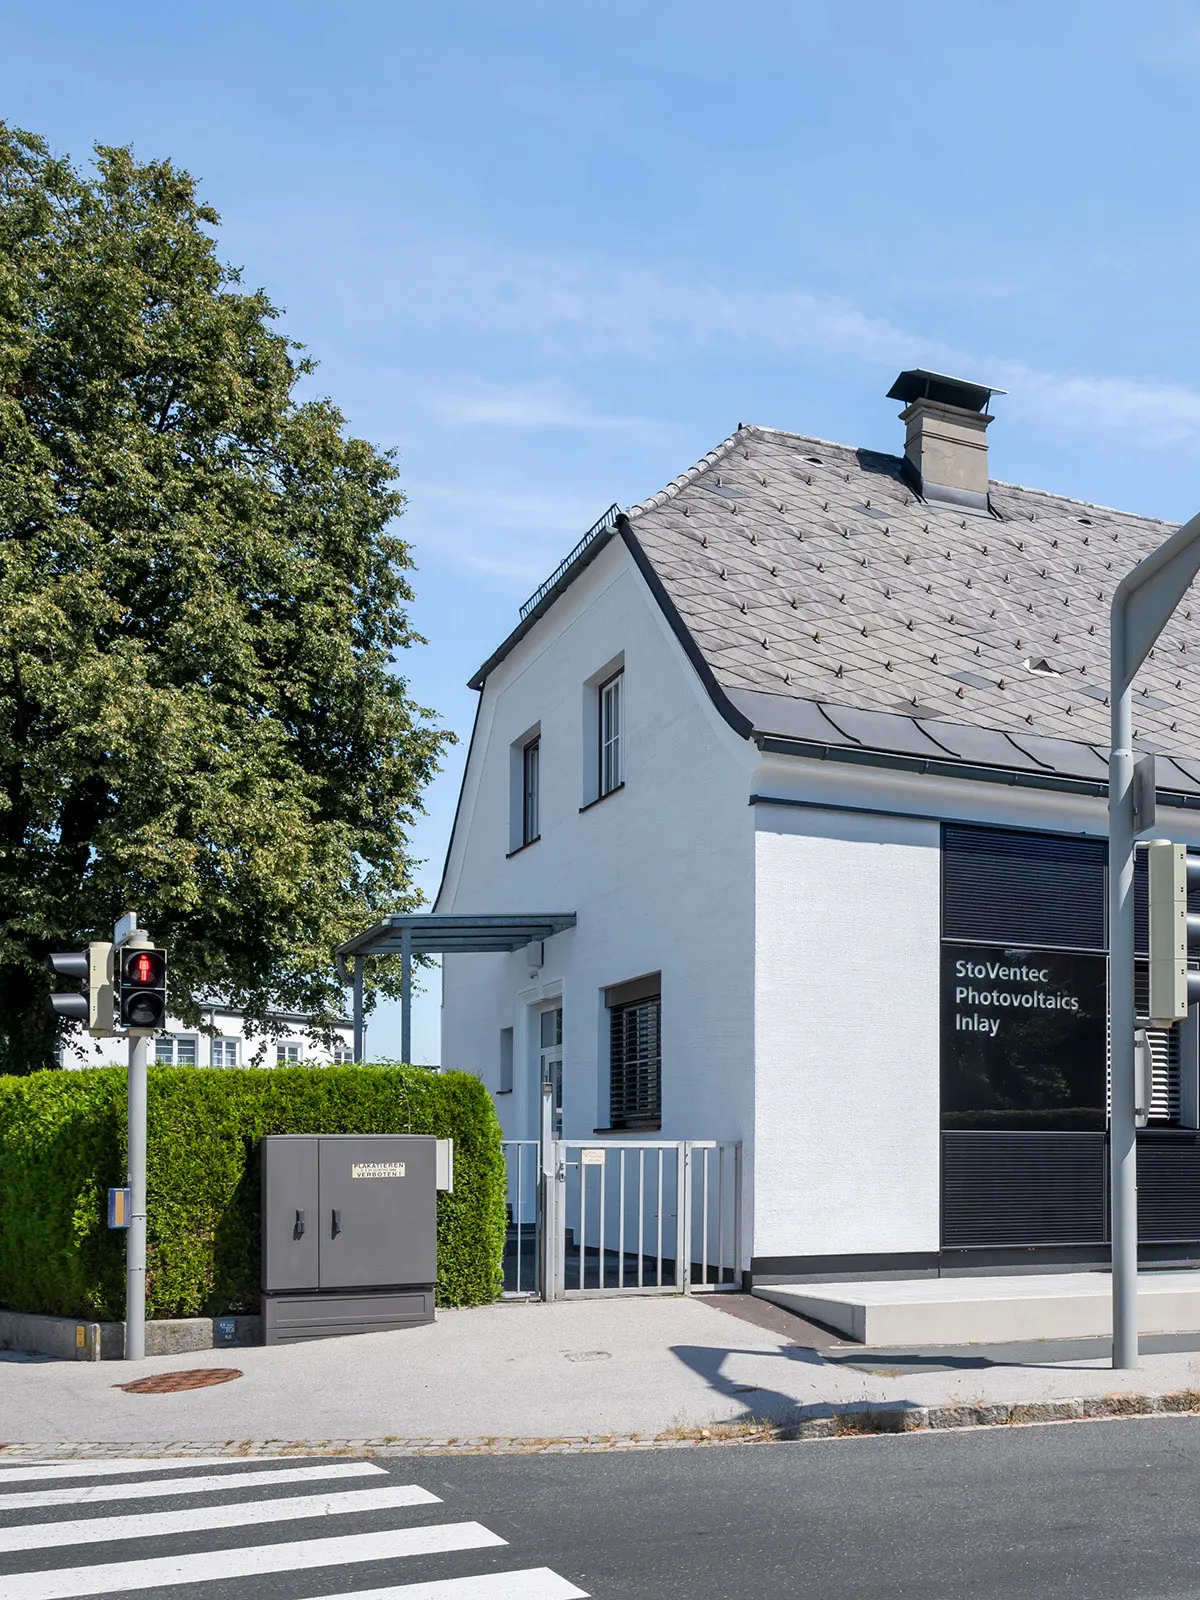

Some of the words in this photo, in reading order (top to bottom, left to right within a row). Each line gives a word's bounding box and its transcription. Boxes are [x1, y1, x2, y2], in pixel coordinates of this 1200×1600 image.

[956, 960, 1049, 982] StoVentec
[956, 986, 1079, 1010] Photovoltaics
[956, 1013, 1000, 1037] Inlay
